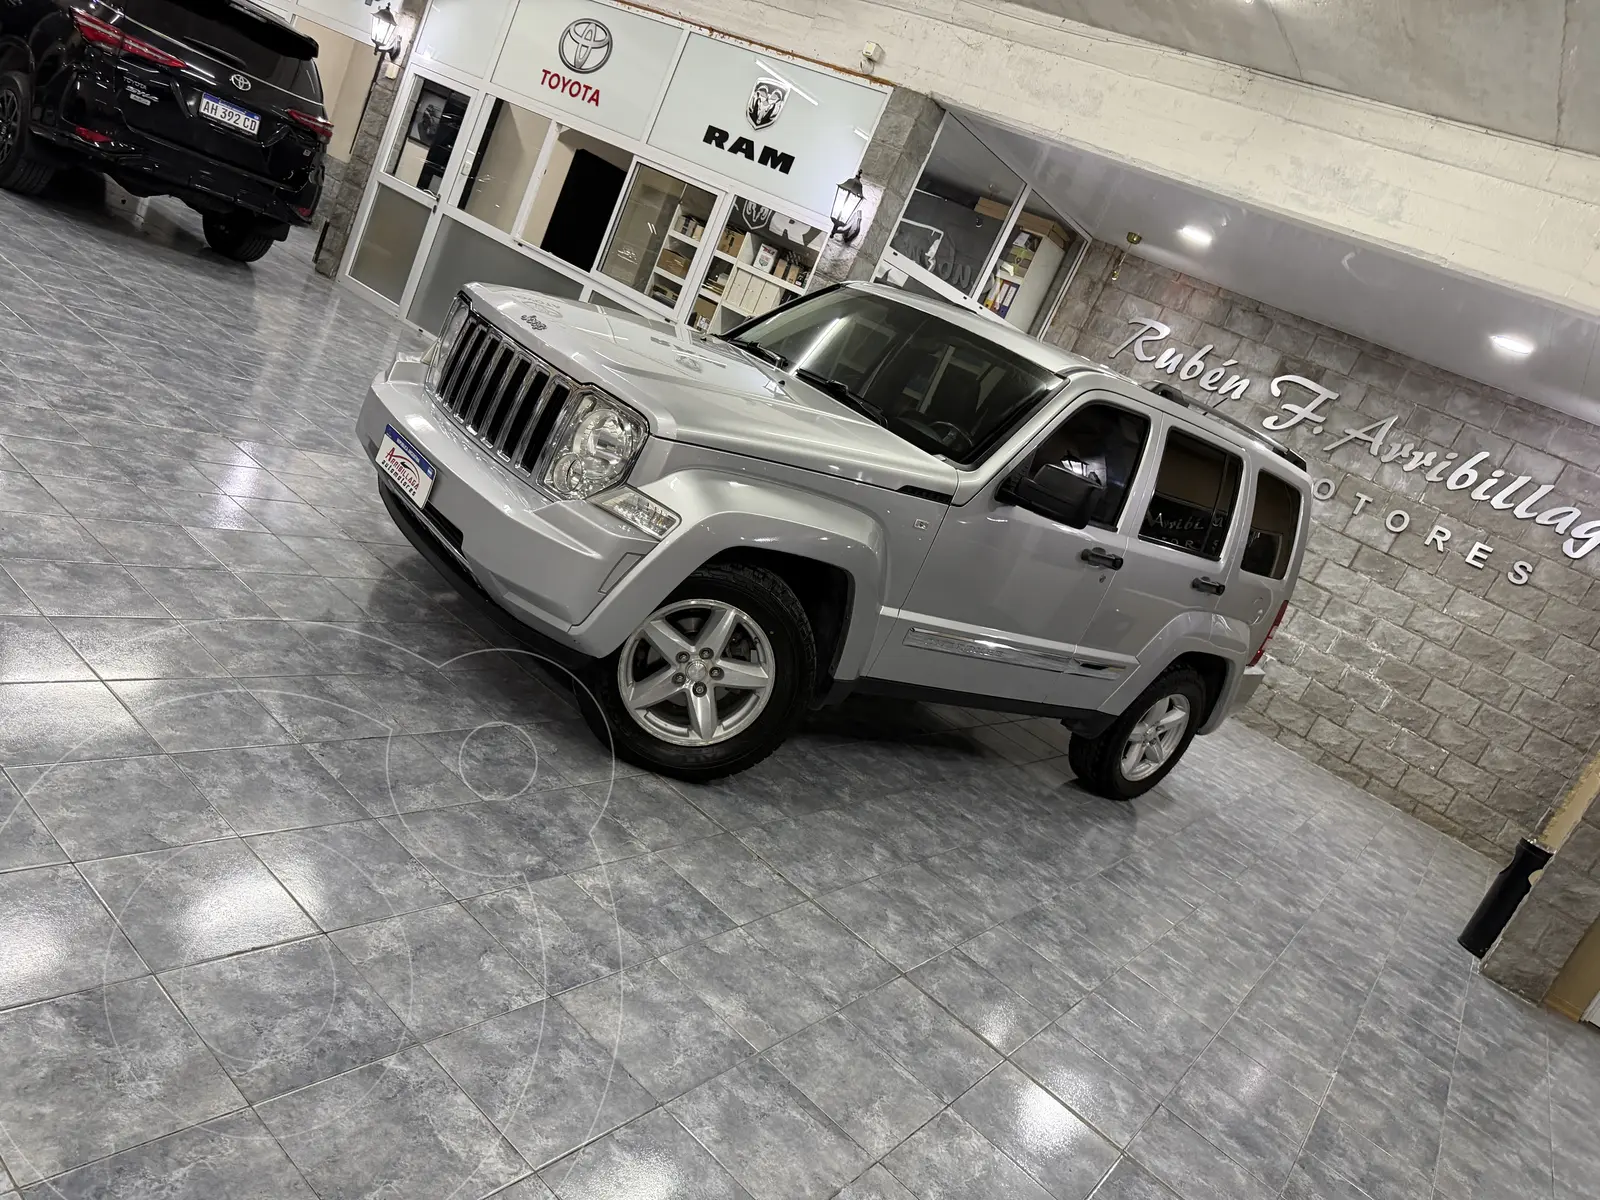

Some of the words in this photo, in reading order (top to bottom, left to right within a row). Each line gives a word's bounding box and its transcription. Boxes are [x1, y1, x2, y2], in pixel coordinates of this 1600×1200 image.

[540, 69, 601, 107] TOYOTA
[203, 101, 218, 116] AH
[220, 107, 241, 125] 392
[243, 117, 257, 131] CD
[703, 125, 795, 175] RAM
[1108, 317, 1250, 400] Rubén
